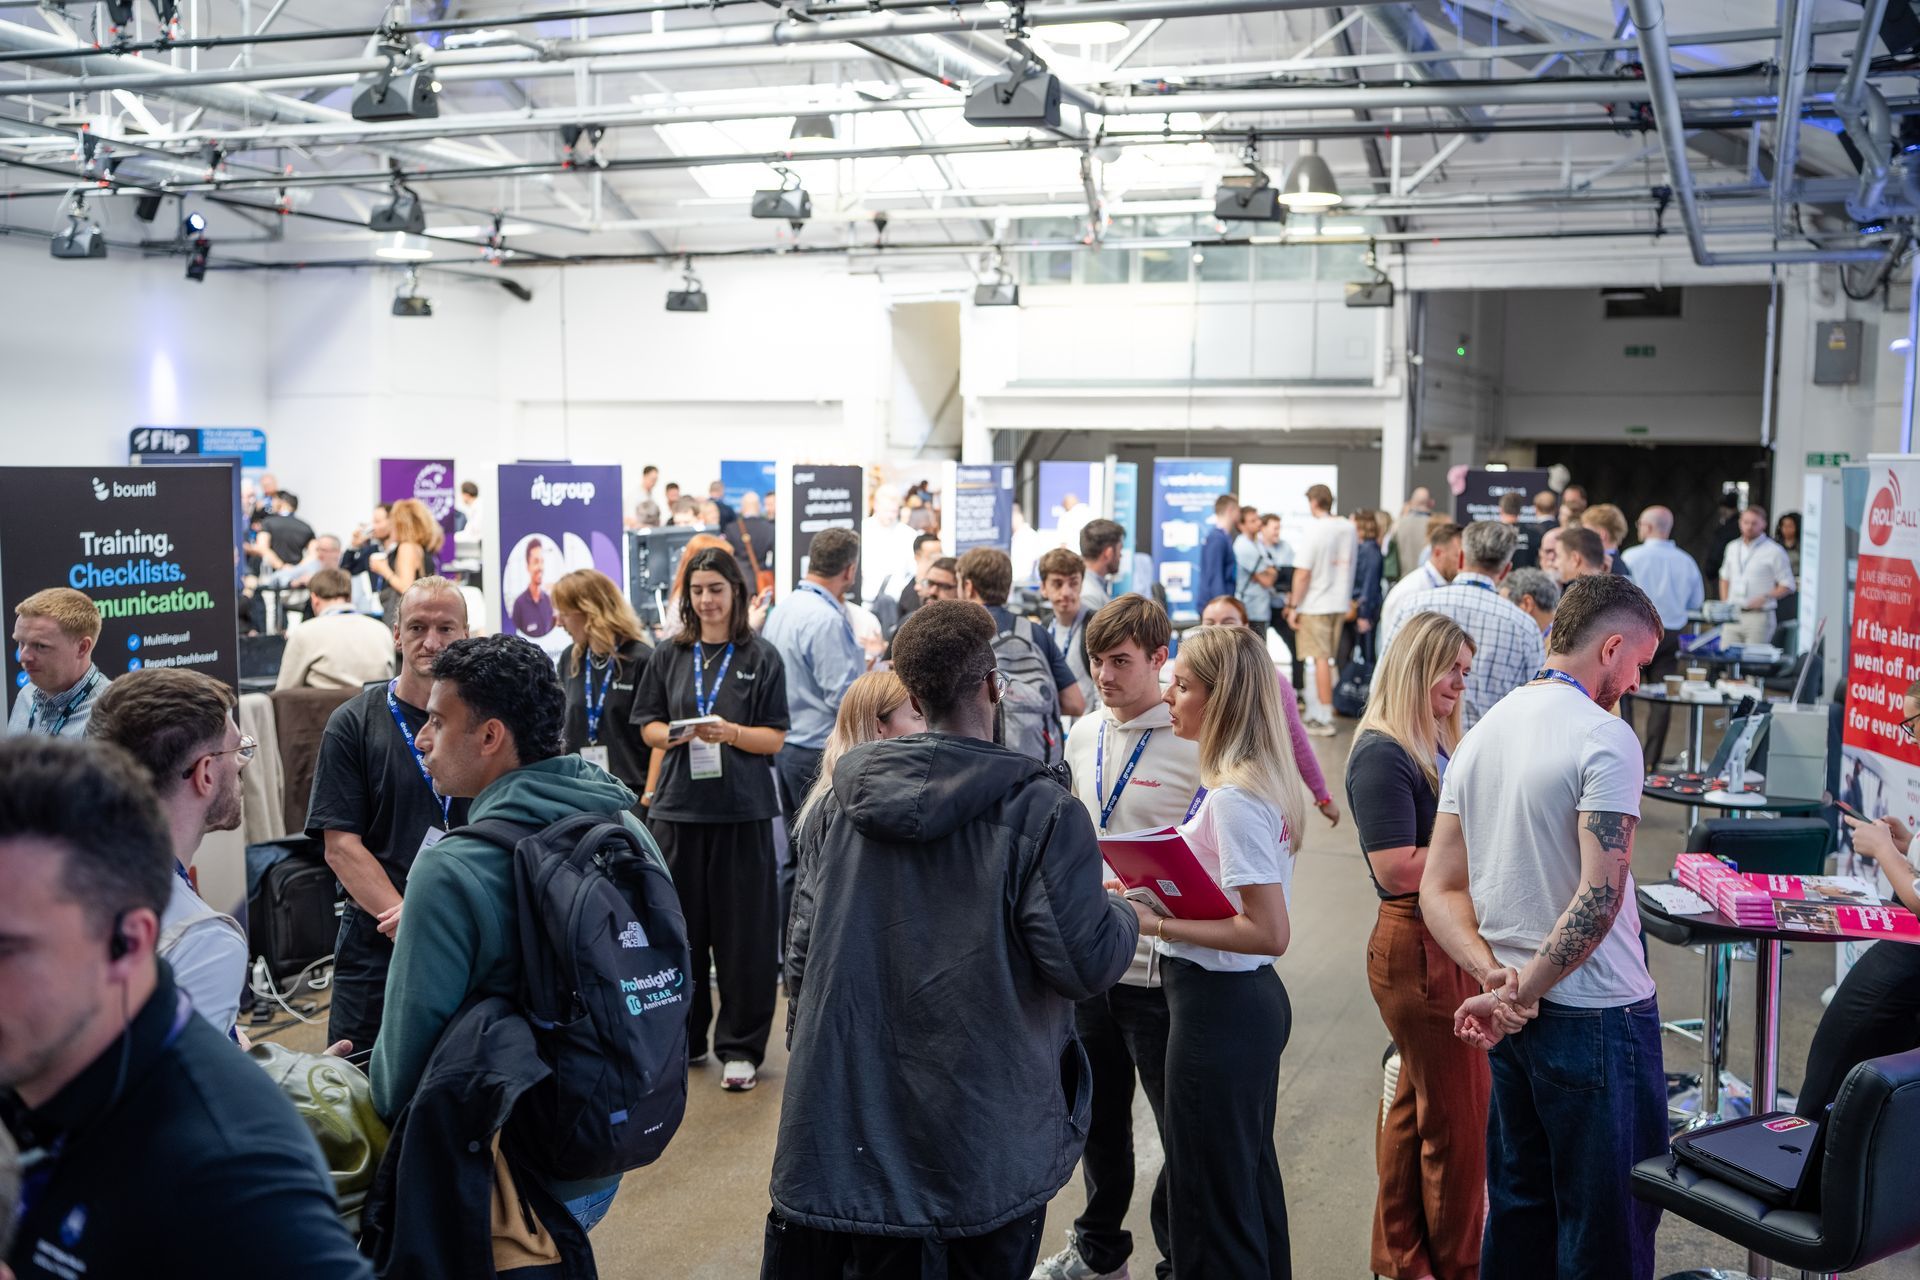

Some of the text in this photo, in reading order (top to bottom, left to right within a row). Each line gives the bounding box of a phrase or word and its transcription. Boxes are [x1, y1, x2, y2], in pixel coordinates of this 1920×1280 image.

[150, 429, 190, 455] Flip
[113, 480, 157, 498] bounti
[79, 528, 174, 558] Training.
[69, 559, 186, 589] Checklists.
[1878, 571, 1913, 589] EMERGENCY
[93, 587, 215, 618] munication.
[1859, 586, 1912, 605] ACCOUNTABILITY
[143, 630, 190, 647] Multilingual
[1857, 618, 1868, 640] If
[1870, 621, 1888, 645] the
[176, 649, 218, 666] Dashboard
[1854, 652, 1884, 674] went
[1886, 656, 1904, 679] off
[1851, 682, 1904, 713] could yo
[1849, 706, 1870, 732] for
[1122, 762, 1135, 780] group
[1107, 795, 1118, 812] group
[1189, 797, 1202, 815] group
[643, 993, 682, 1011] Anniversary
[646, 989, 672, 1003] YEAR
